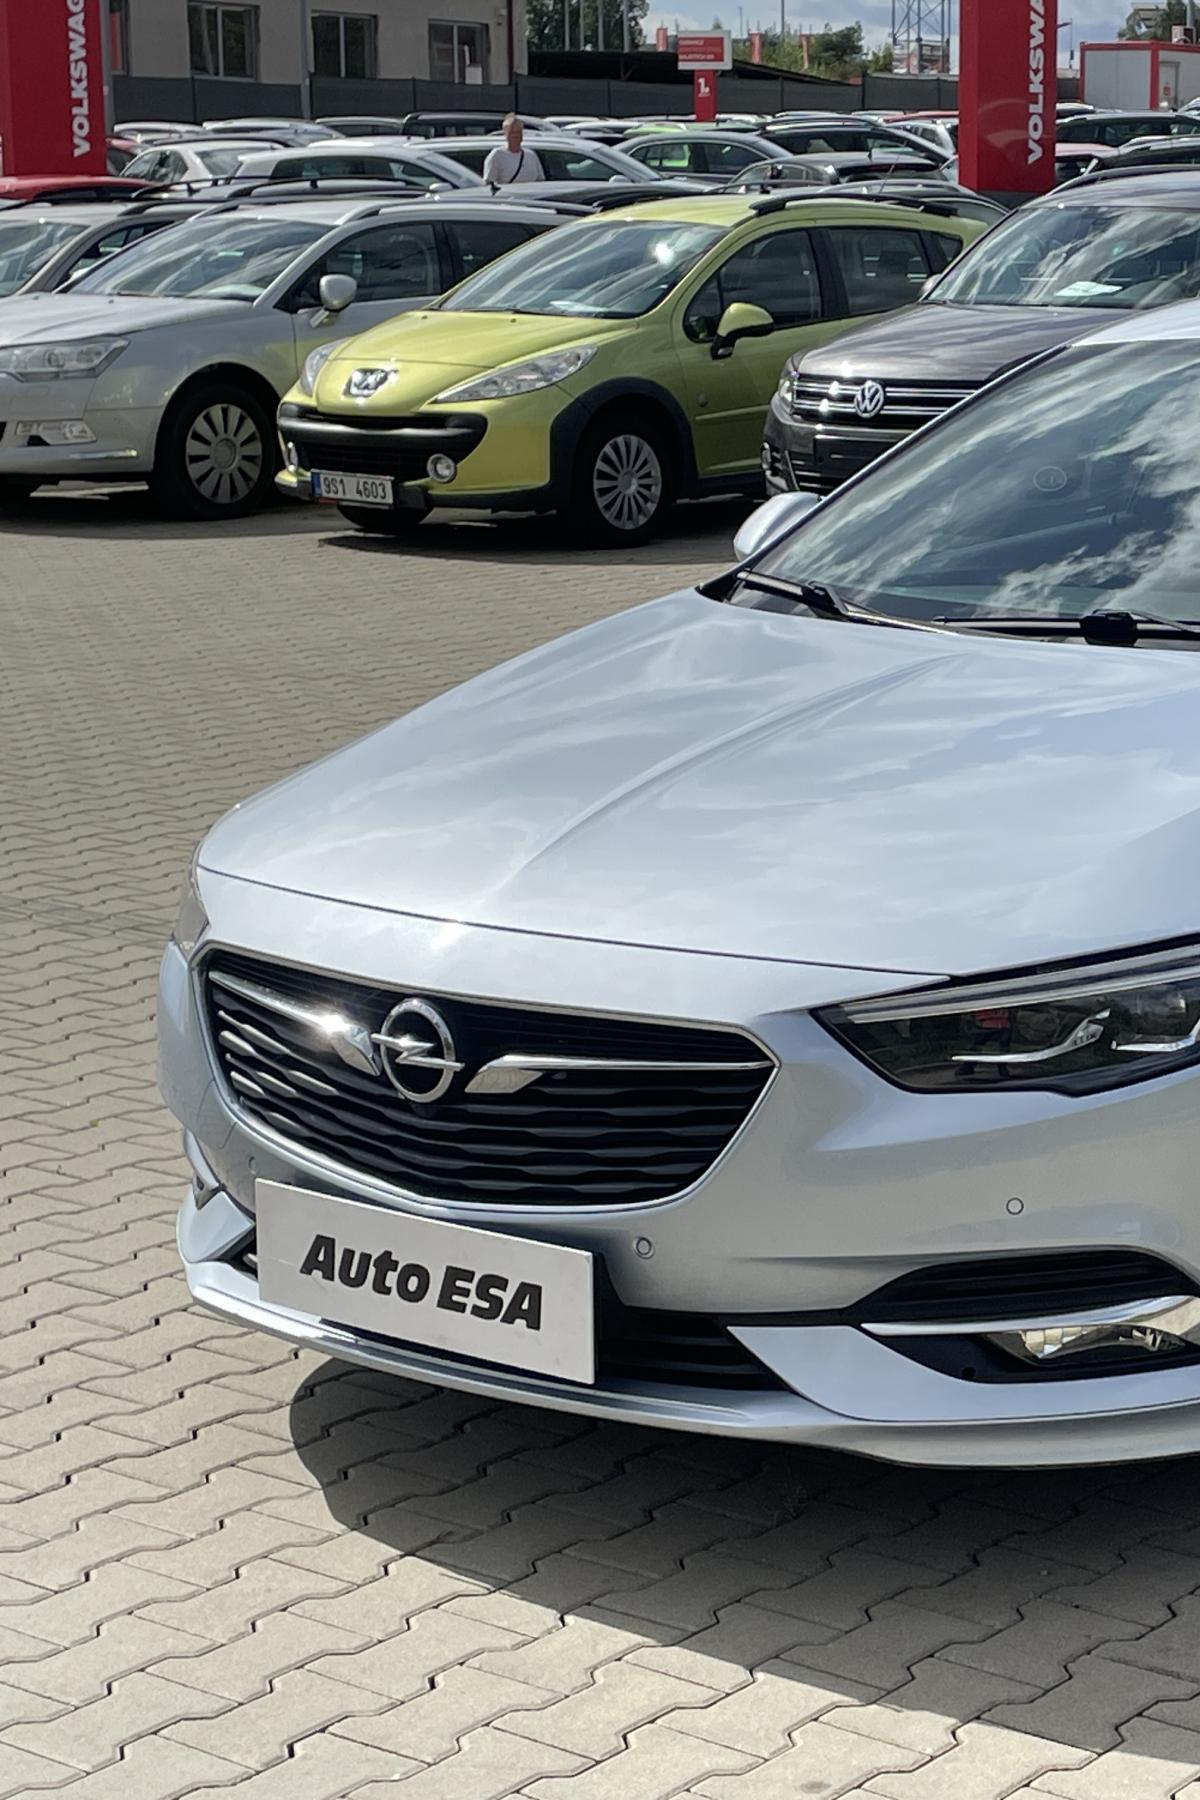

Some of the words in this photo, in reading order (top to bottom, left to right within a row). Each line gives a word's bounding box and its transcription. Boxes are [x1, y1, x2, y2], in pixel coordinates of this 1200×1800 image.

[323, 477, 346, 496] 9S1
[356, 480, 387, 499] 4603
[299, 1234, 430, 1303] Auto
[436, 1265, 543, 1332] ESA
